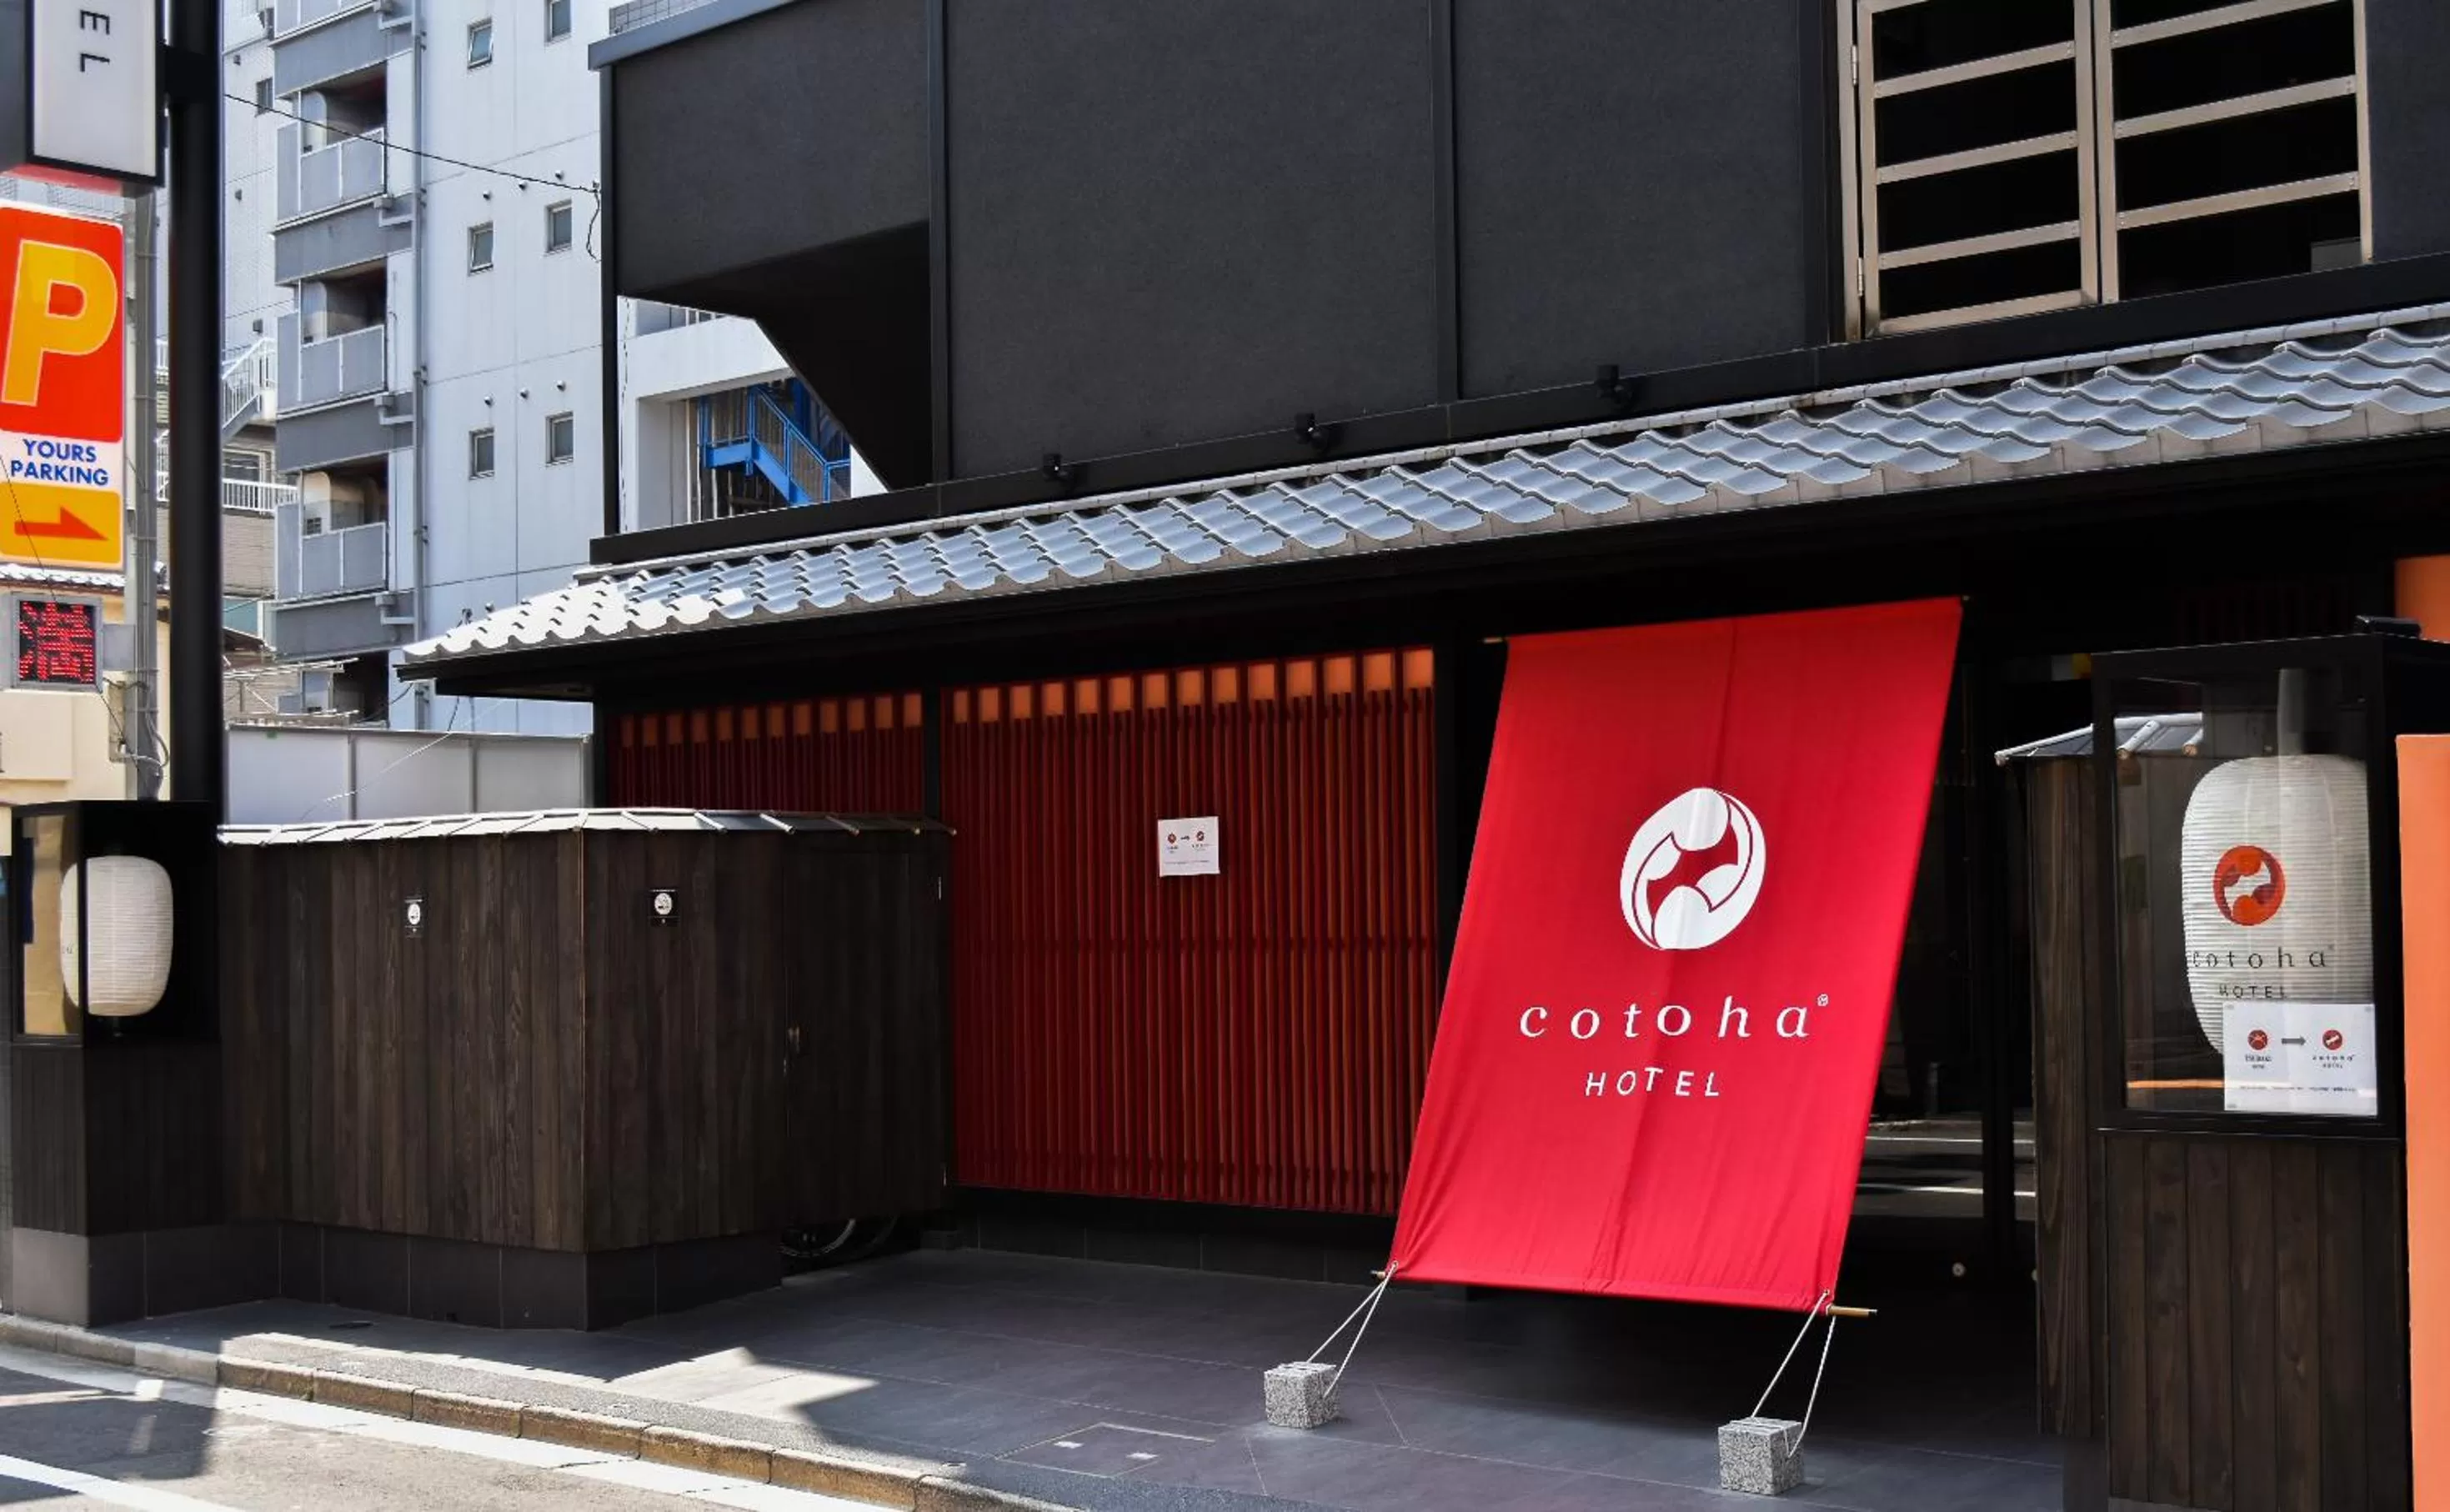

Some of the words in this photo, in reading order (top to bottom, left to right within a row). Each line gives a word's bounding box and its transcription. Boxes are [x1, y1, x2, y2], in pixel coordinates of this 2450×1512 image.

[1, 238, 118, 407] P
[23, 438, 97, 463] YOURS
[10, 459, 109, 486] PARKING
[2219, 986, 2287, 999] HOTEL
[1585, 1066, 1720, 1097] HOTEL
